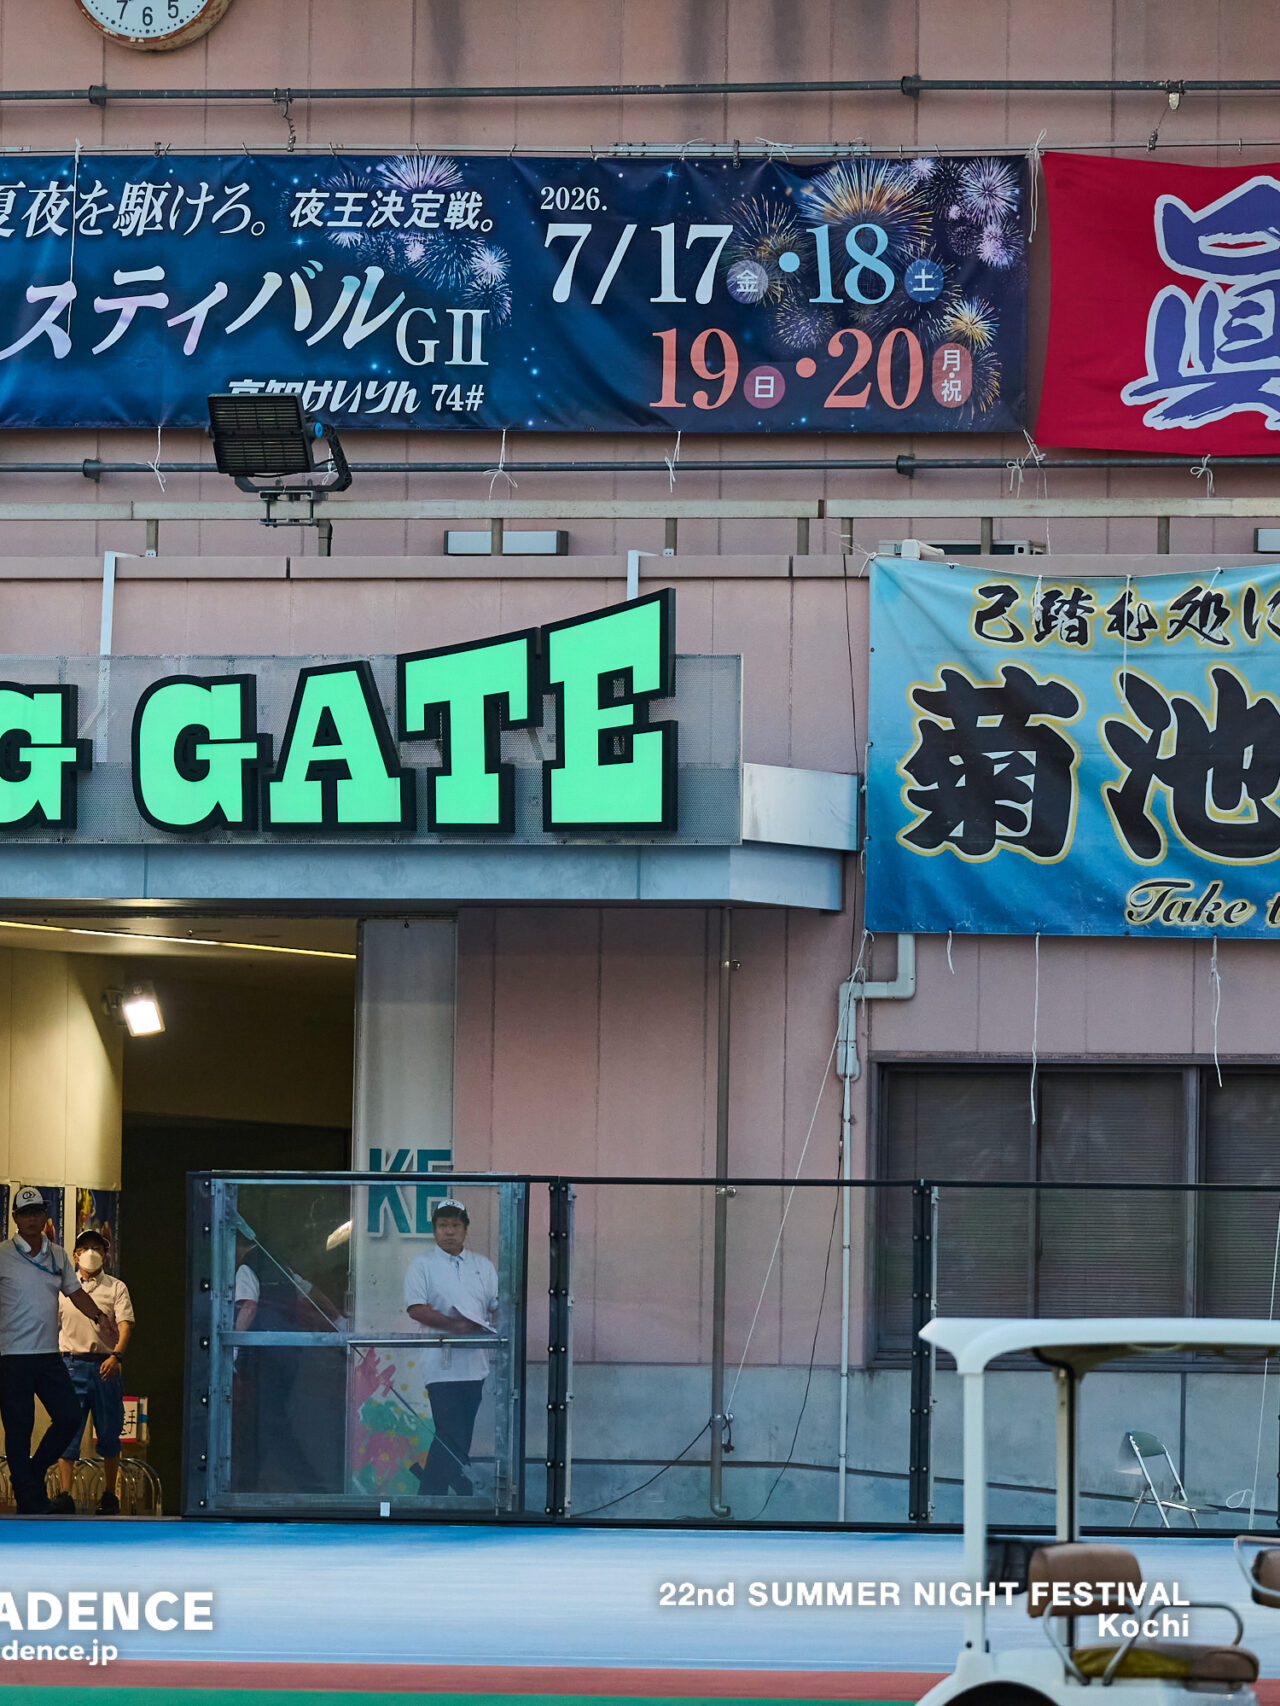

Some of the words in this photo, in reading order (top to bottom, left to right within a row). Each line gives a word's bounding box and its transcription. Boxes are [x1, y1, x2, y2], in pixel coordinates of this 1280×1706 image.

[142, 7, 153, 26] 6
[167, 0, 179, 18] 5
[540, 186, 608, 211] 2026.
[544, 223, 733, 305] 7/17
[736, 269, 759, 293] 金
[912, 269, 935, 292] 土
[431, 384, 484, 411] 74#
[650, 328, 738, 410] 19
[755, 377, 775, 399] 日
[134, 592, 675, 829] GATE
[900, 666, 1280, 860] 菊池
[1127, 880, 1253, 925] Take
[367, 1148, 451, 1234] KE
